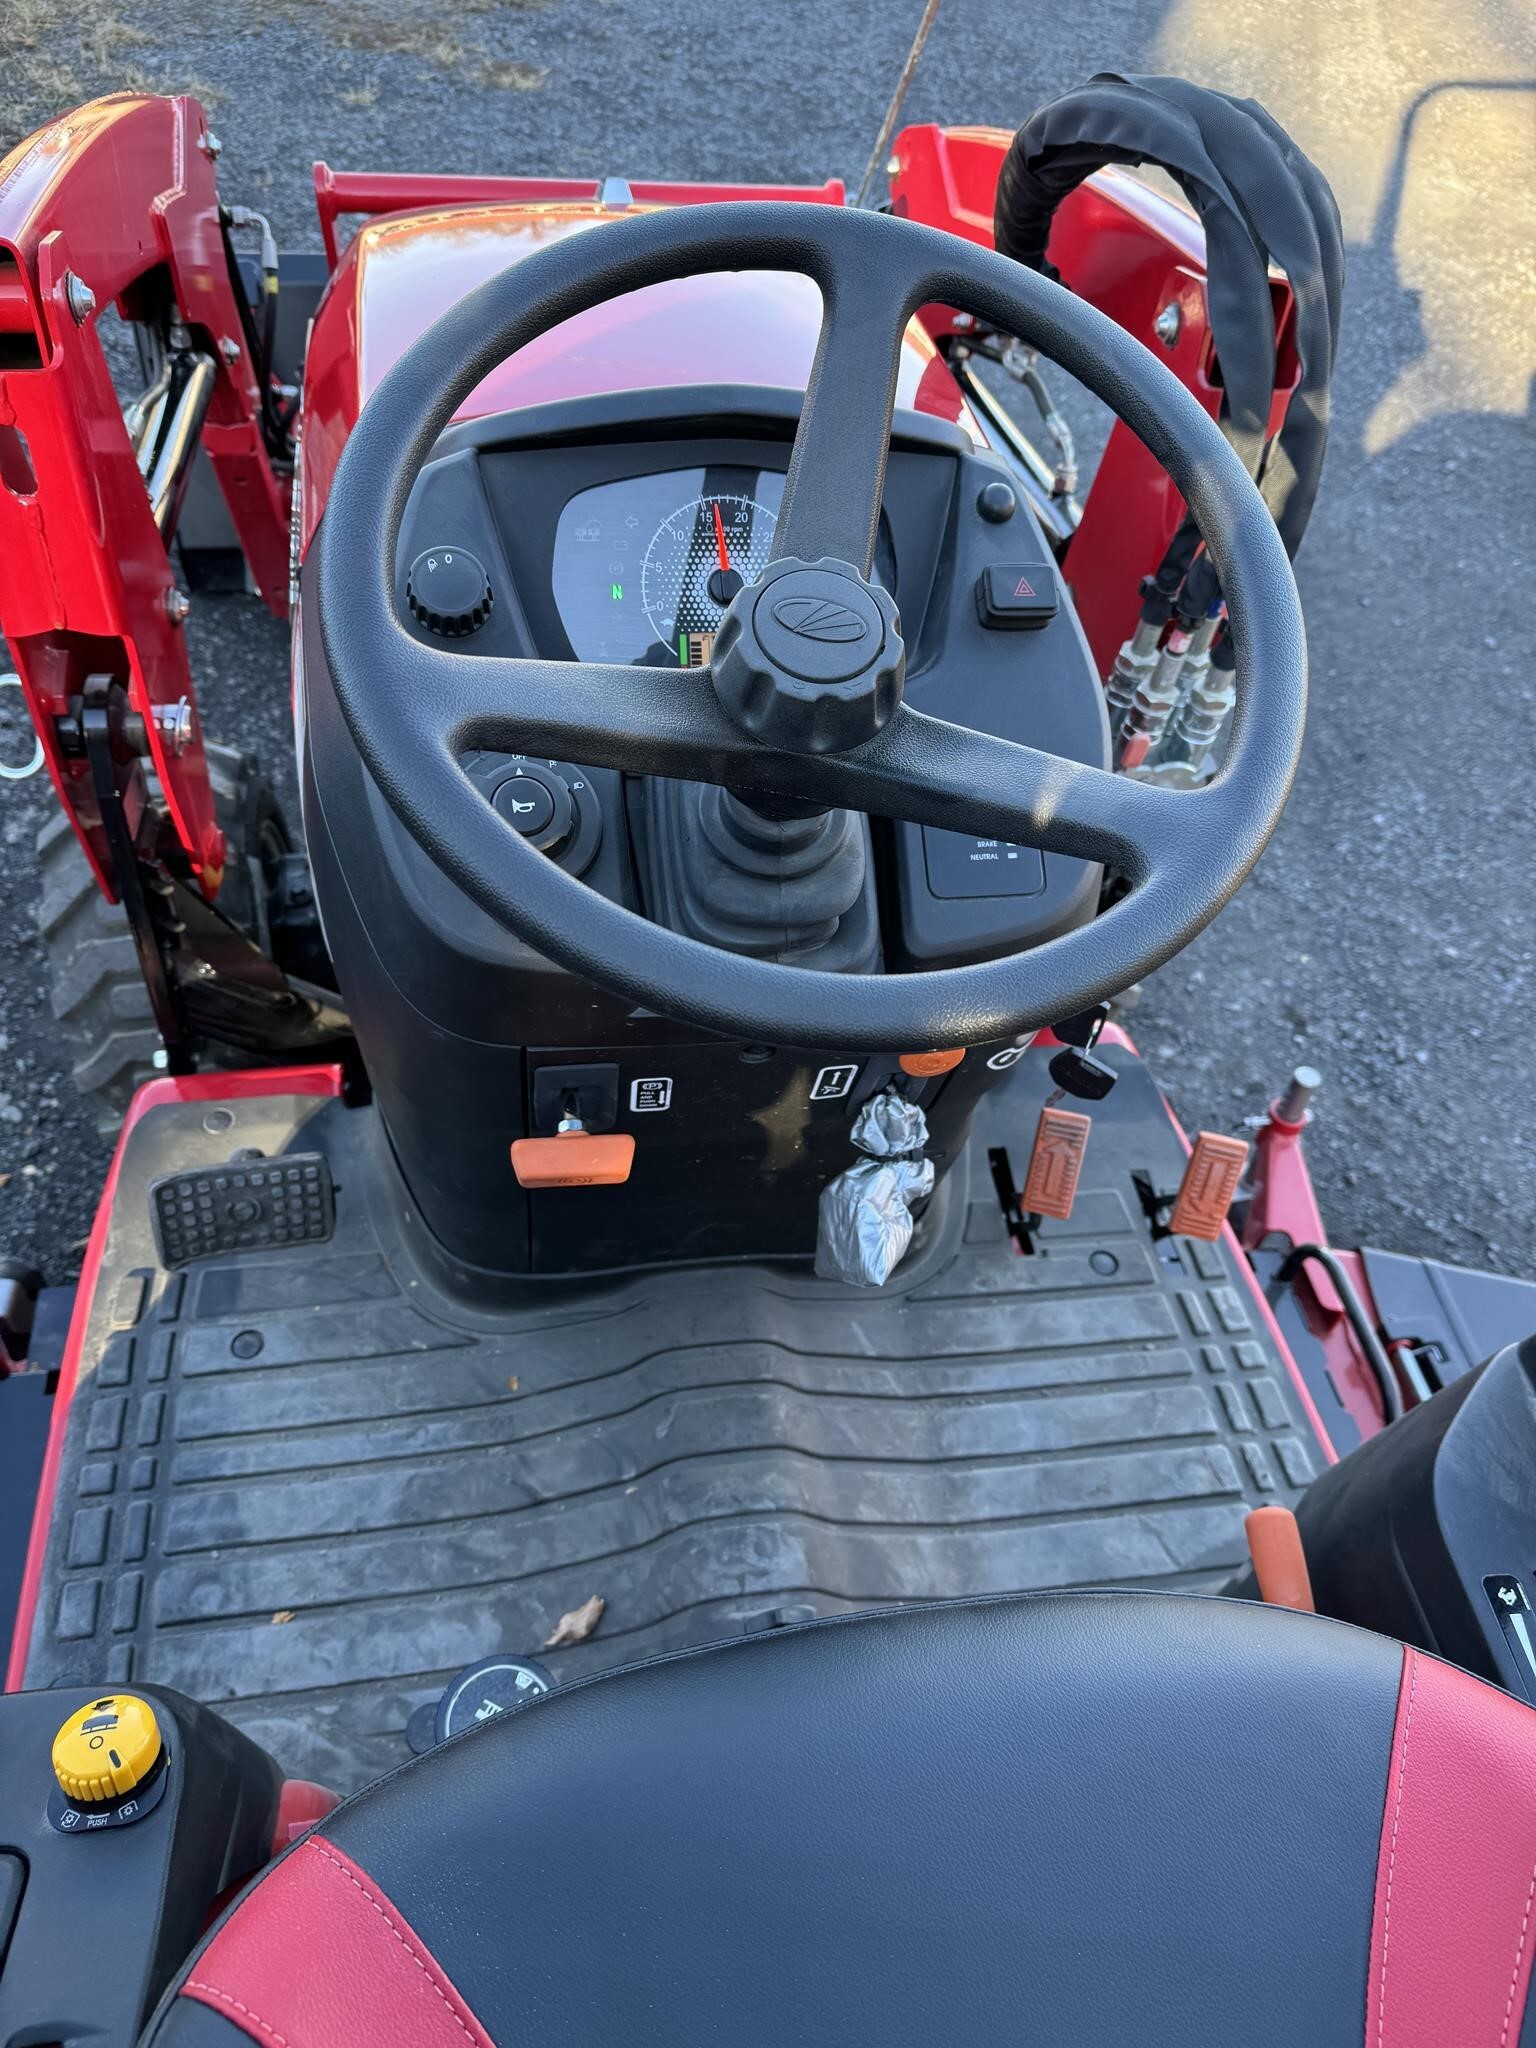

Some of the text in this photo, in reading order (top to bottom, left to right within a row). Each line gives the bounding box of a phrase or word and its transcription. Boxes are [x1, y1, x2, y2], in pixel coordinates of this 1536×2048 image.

[700, 512, 713, 523] 15
[735, 512, 748, 523] 20
[672, 531, 685, 541] 10
[655, 562, 663, 573] 5
[612, 584, 623, 600] N
[657, 601, 664, 611] 0
[977, 840, 998, 848] BRAKE
[970, 853, 999, 861] NEUTRAL
[87, 1818, 108, 1828] PUSH
